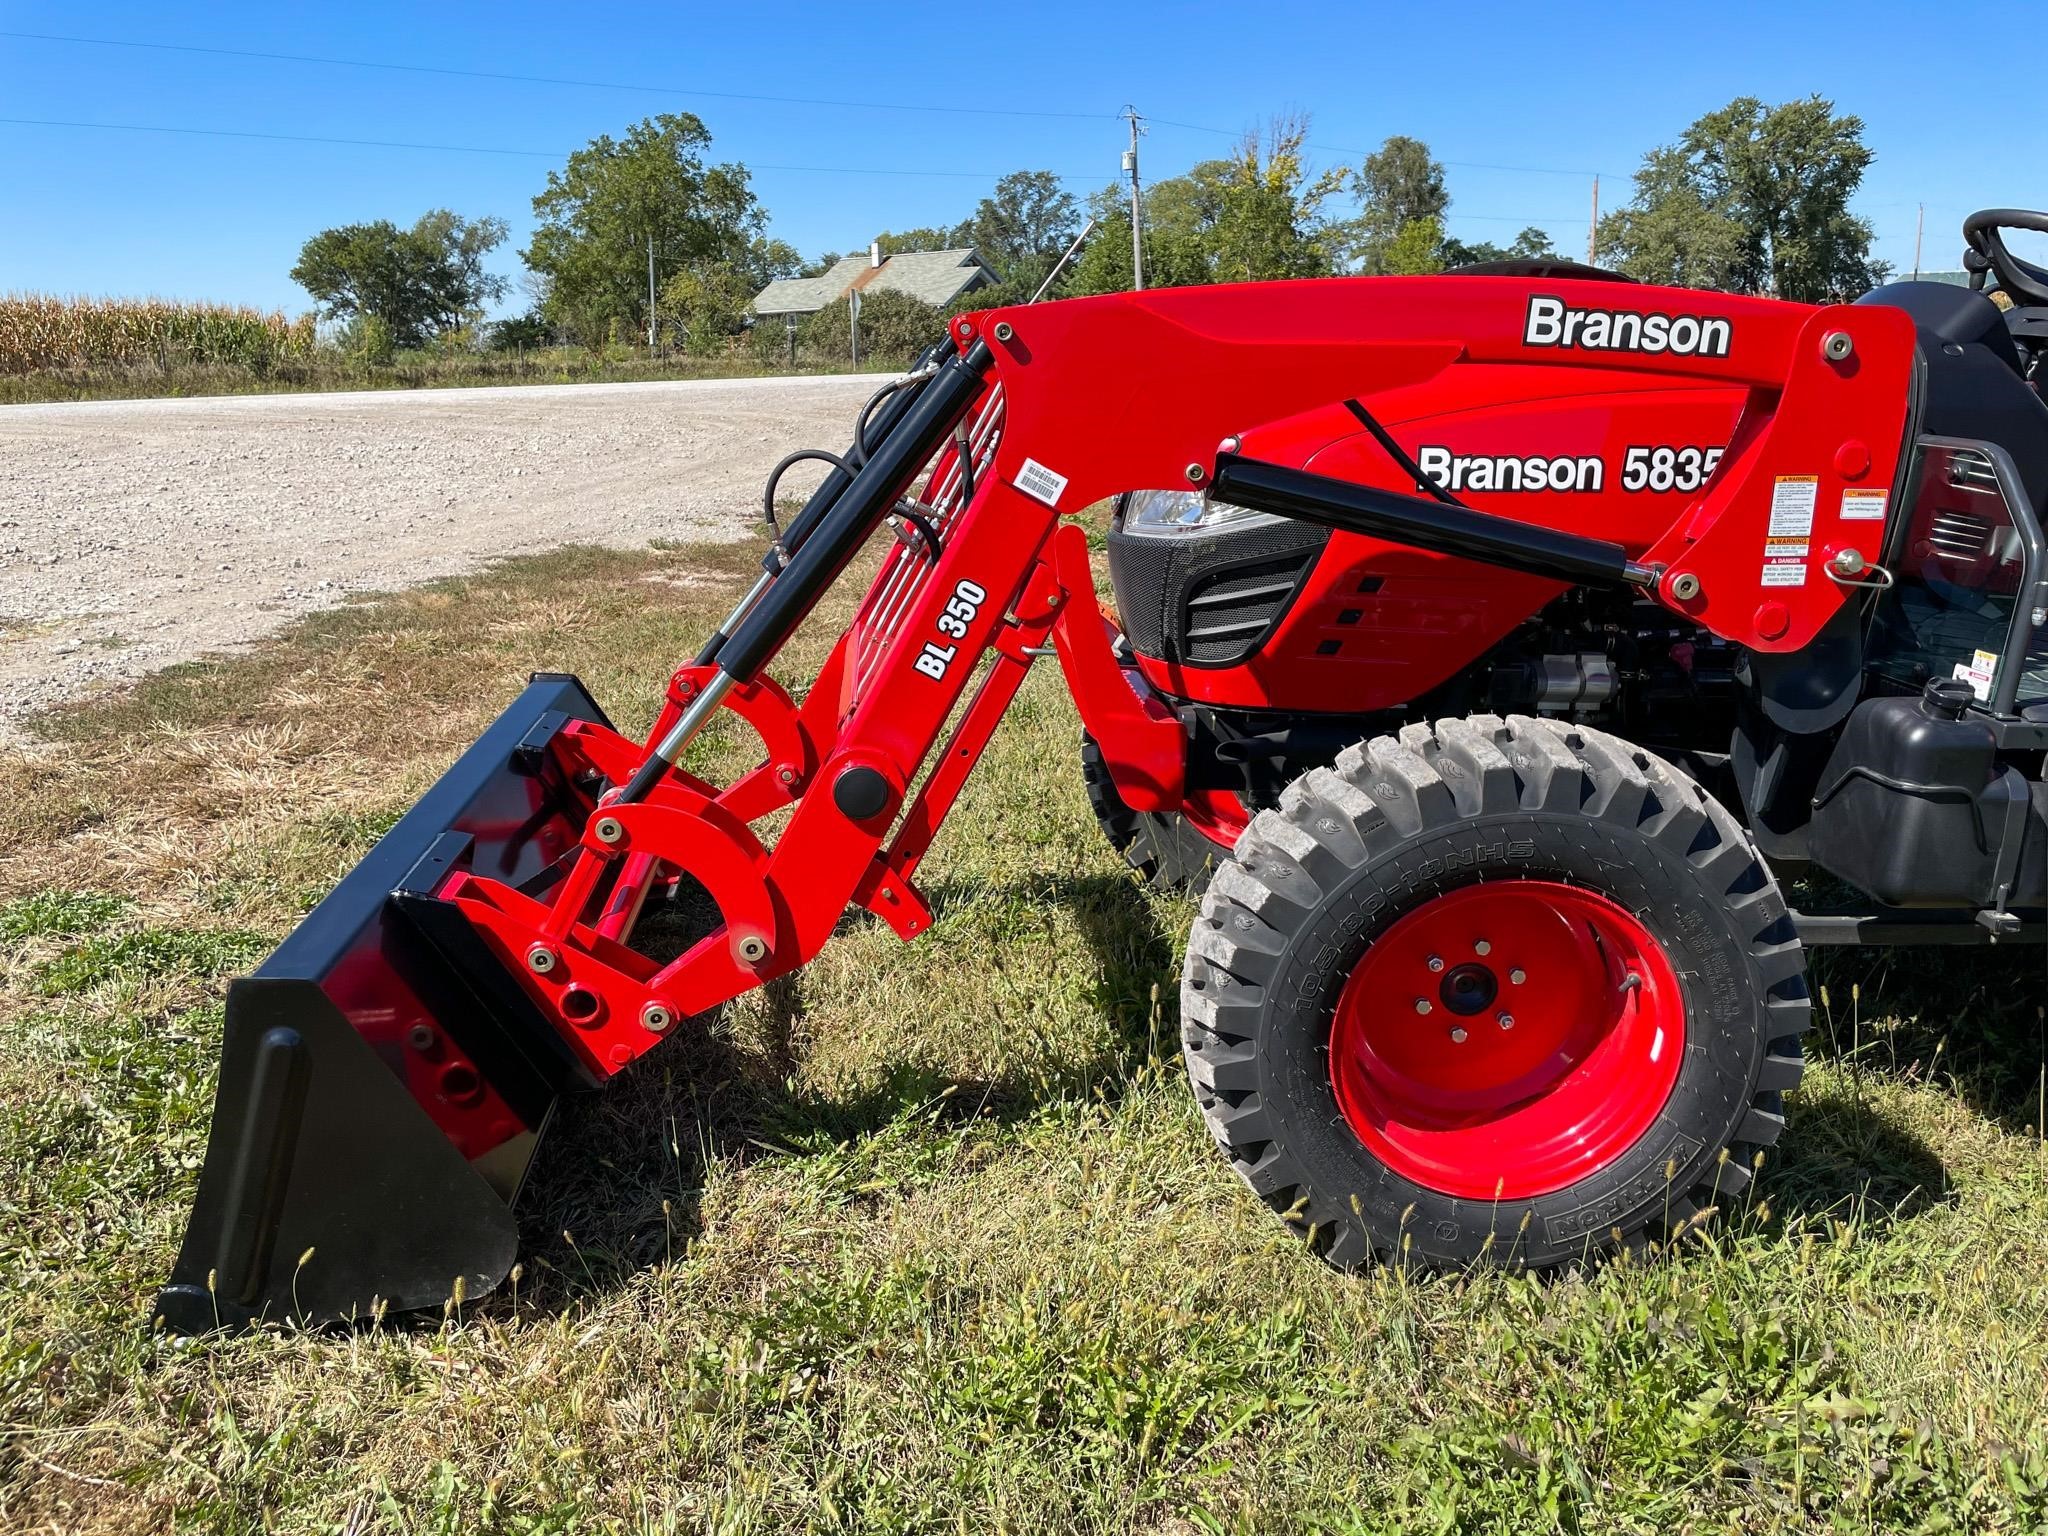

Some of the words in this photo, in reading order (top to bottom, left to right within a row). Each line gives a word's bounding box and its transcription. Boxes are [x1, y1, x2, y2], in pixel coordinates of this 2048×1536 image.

[1525, 296, 1731, 356] Branson
[1417, 446, 1604, 490] Branson
[1776, 537, 1807, 545] WARNING
[914, 642, 957, 681] BL
[937, 579, 986, 639] 350
